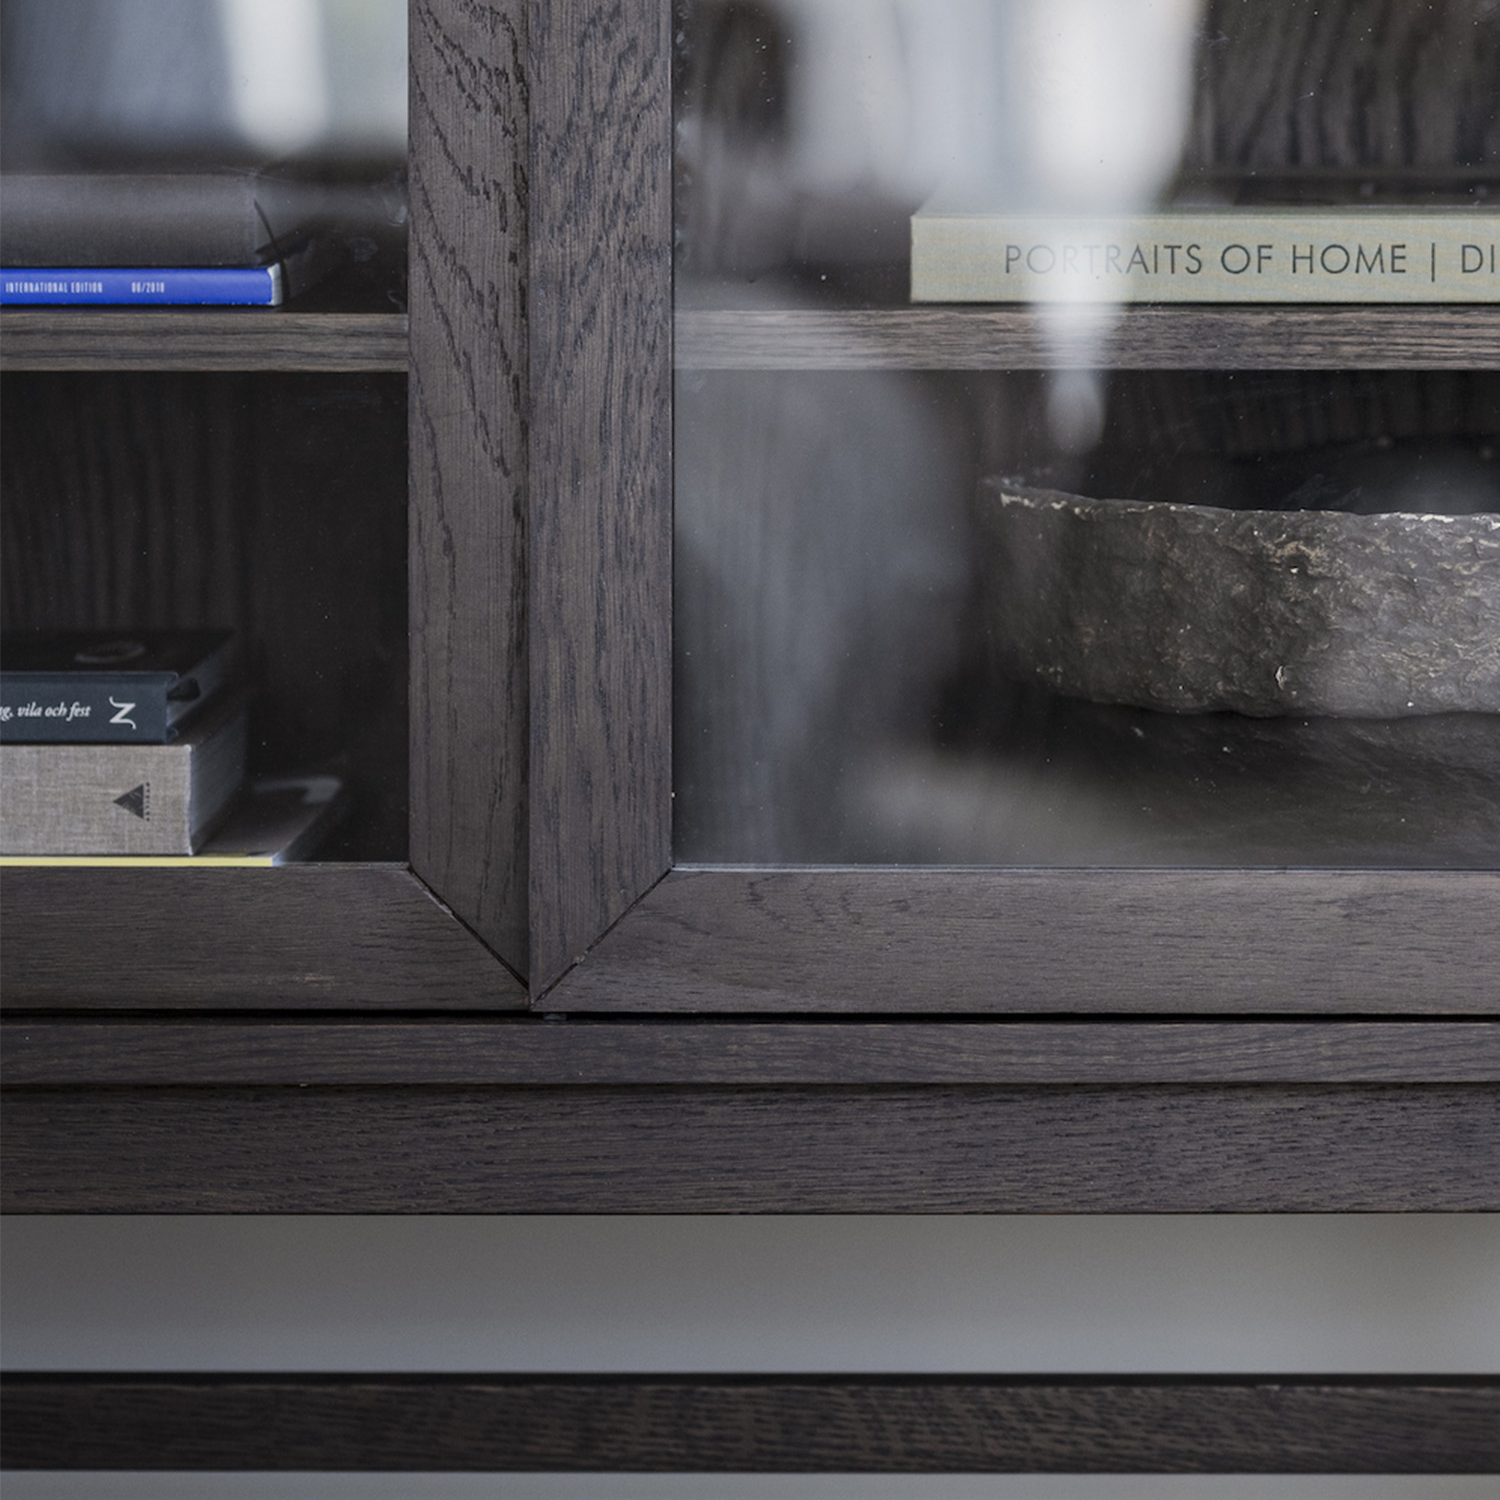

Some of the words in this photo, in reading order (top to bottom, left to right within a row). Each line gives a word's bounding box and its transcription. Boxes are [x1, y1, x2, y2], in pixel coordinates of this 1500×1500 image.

[1004, 243, 1203, 275] PORTRAITS
[1220, 243, 1274, 275] OF
[1291, 243, 1408, 275] HOME
[5, 282, 68, 294] INTERNATIONAL
[70, 282, 103, 294] EDITION
[17, 701, 42, 717] vila
[44, 701, 68, 717] och
[65, 701, 92, 722] fest
